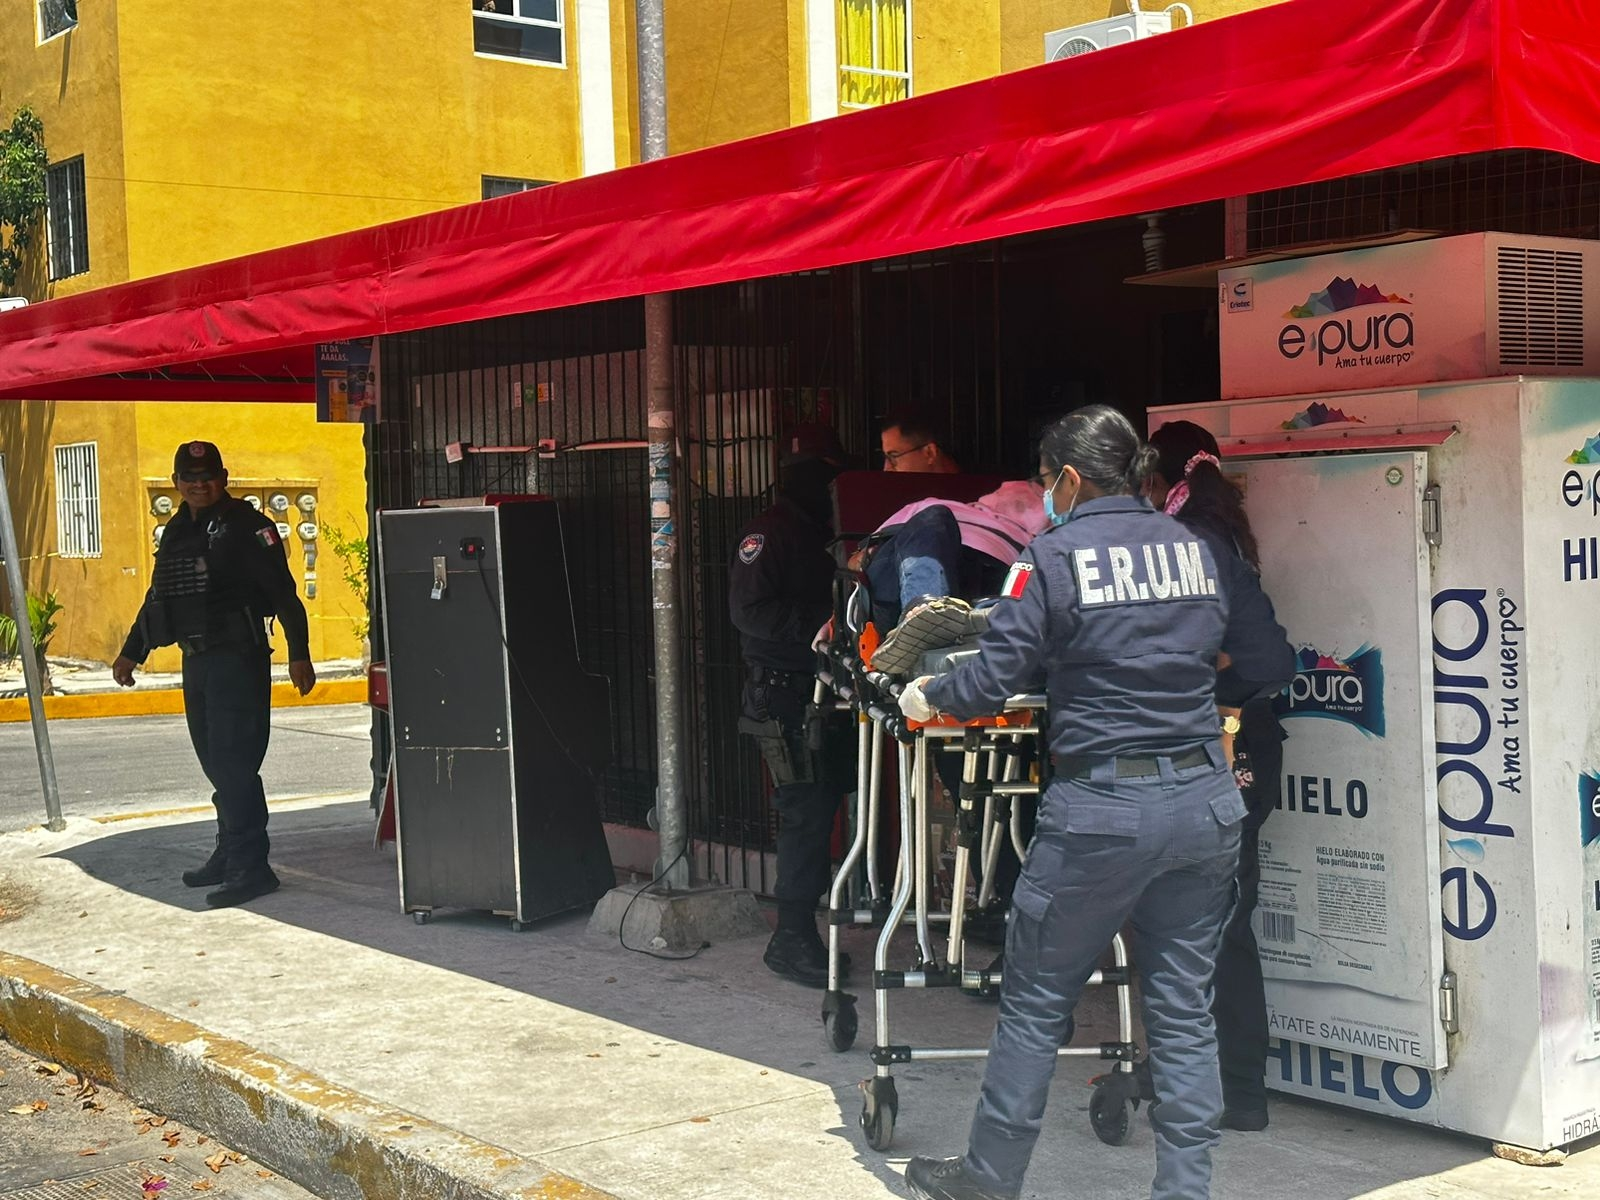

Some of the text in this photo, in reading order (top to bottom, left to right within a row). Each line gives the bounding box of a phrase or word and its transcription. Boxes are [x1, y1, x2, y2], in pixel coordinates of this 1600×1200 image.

[1335, 356, 1357, 368] Ama
[1360, 354, 1372, 366] tu
[1075, 541, 1216, 604] E.R.U.M.
[1497, 697, 1519, 728] tu
[1498, 736, 1521, 793] Ama
[1315, 846, 1385, 862] HIELO ELABORADO CON
[1317, 855, 1386, 872] Agua purificada sin sodio
[1269, 1010, 1422, 1057] ÁTATE SANAMENTE
[1563, 1111, 1600, 1142] HIDRÁ
